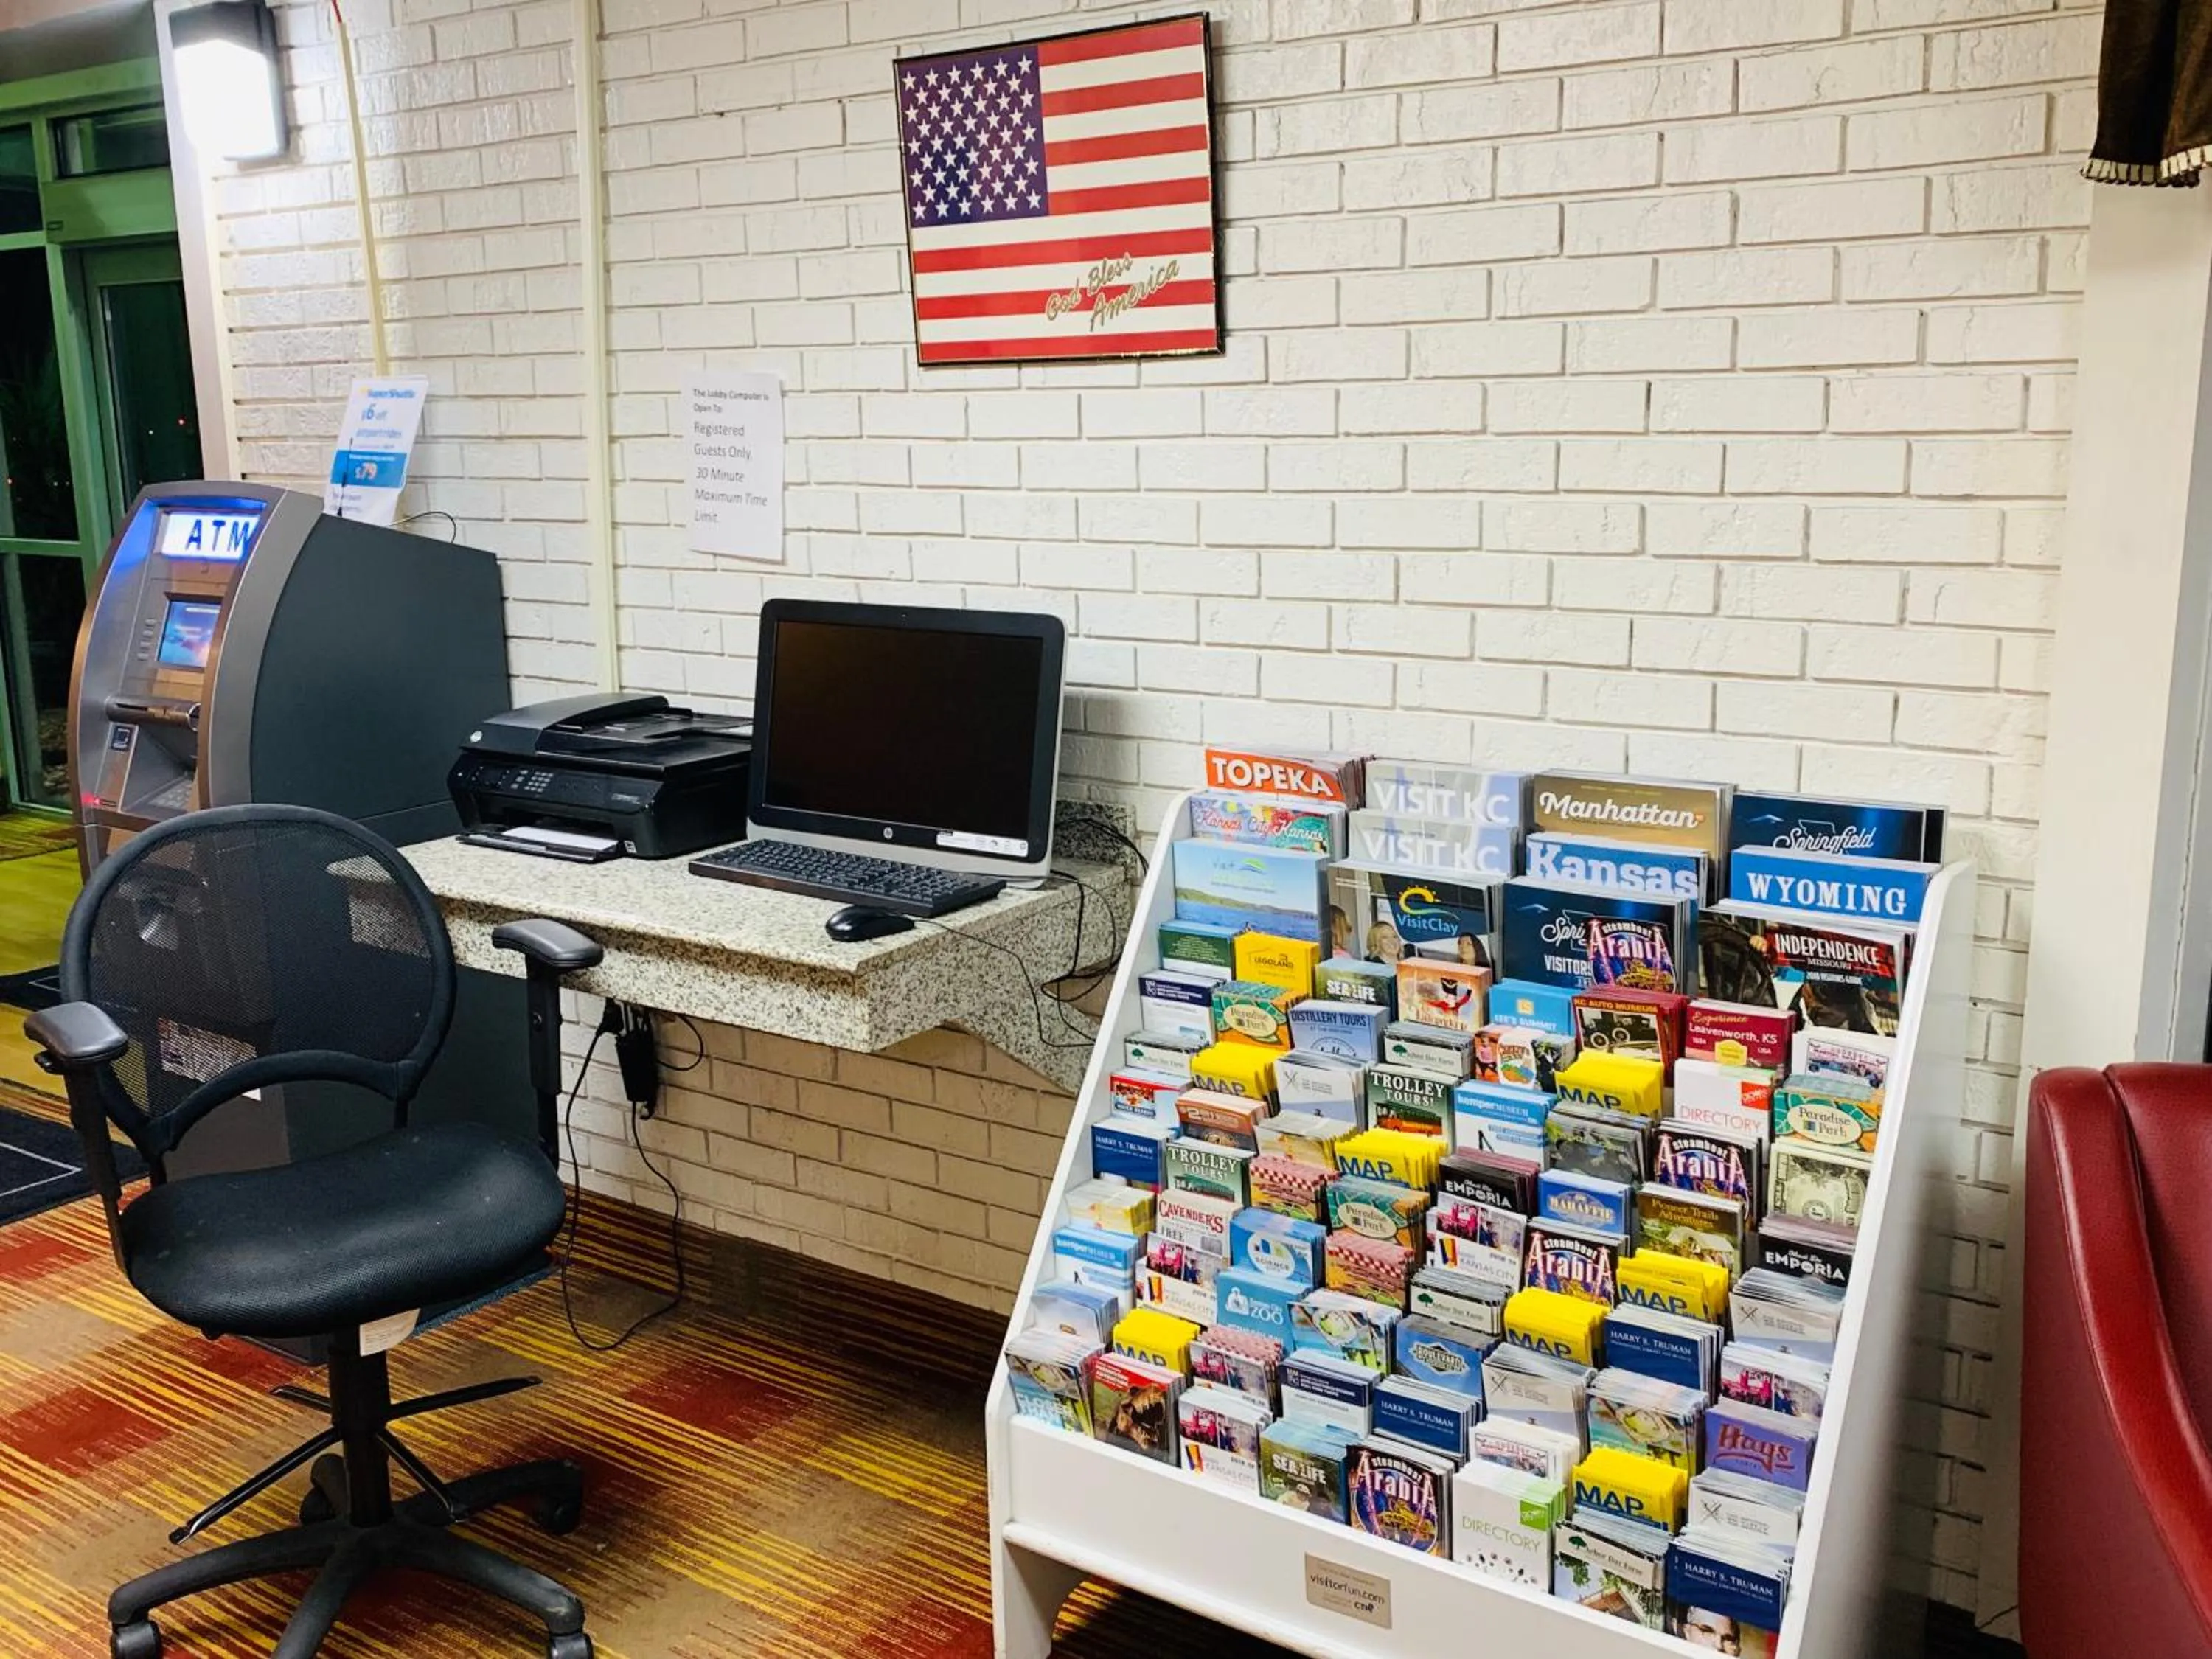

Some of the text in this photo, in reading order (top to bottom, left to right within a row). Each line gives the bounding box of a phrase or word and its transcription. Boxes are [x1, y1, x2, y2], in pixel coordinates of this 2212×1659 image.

[1046, 251, 1133, 321] God Bless
[1089, 259, 1180, 332] America
[693, 389, 706, 398] The
[707, 389, 727, 400] Lobby
[729, 391, 763, 402] Computer
[694, 403, 712, 414] Open
[694, 421, 745, 437] Registered
[694, 443, 726, 457] Guests
[696, 467, 745, 483] 30 Minute
[695, 489, 768, 507] Maximum Time
[186, 518, 254, 554] ATM
[1211, 757, 1333, 797] TOPEKA
[1373, 782, 1510, 824] VISIT KC
[1538, 791, 1697, 830] Manhattan
[1273, 818, 1323, 841] Kansas
[1772, 825, 1877, 855] Springfield
[1362, 838, 1501, 874] VISIT KC
[1526, 840, 1698, 896] Kansas
[1746, 872, 1907, 916] WYOMING
[1396, 911, 1459, 937] VisitClay
[1253, 956, 1294, 968] LEGOLAND
[1775, 933, 1879, 965] INDEPENDENCE
[1543, 954, 1593, 975] VISITORS
[1807, 957, 1851, 970] MISSOURI
[1326, 979, 1376, 1002] SEA LIFE
[1574, 998, 1658, 1012] KC AUTO MUSEUM
[1290, 1010, 1367, 1027] DISTILLERY TOURS
[1494, 1014, 1557, 1031] LEE'S SUMMIT
[1692, 1011, 1747, 1026] Experience
[1761, 1033, 1778, 1044] KS
[1193, 1075, 1245, 1096] MAP
[1371, 1071, 1444, 1098] TROLLEY
[1559, 1085, 1621, 1109] MAP
[1384, 1089, 1435, 1107] TOURS!
[1680, 1105, 1761, 1133] DIRECTORY
[1799, 1107, 1851, 1126] Paradise
[1818, 1121, 1848, 1138] Park
[1095, 1135, 1116, 1147] HARRY
[1125, 1142, 1154, 1154] TRUMAN
[1167, 1147, 1239, 1173] TROLLEY
[1338, 1155, 1393, 1179] MAP
[1445, 1180, 1512, 1208] EMPORIA
[1158, 1200, 1224, 1234] CAVENDER'S
[1764, 1251, 1846, 1281] EMPORIA
[1621, 1284, 1688, 1314] MAP
[1250, 1307, 1284, 1325] ZOO
[1116, 1342, 1166, 1366] MAP
[1509, 1328, 1571, 1357] MAP
[1610, 1330, 1641, 1343] HARRY
[1652, 1339, 1691, 1355] TRUMAN
[1381, 1400, 1408, 1414] HARRY
[1419, 1411, 1454, 1428] TRUMAN
[1719, 1423, 1794, 1474] Hays
[1272, 1453, 1327, 1485] SEA LIFE
[1575, 1481, 1644, 1514] MAP
[1462, 1515, 1541, 1552] DIRECTORY
[1310, 1574, 1385, 1605] visitorfun.com
[1685, 1562, 1717, 1579] HARRY
[1730, 1576, 1773, 1596] TRUMAN
